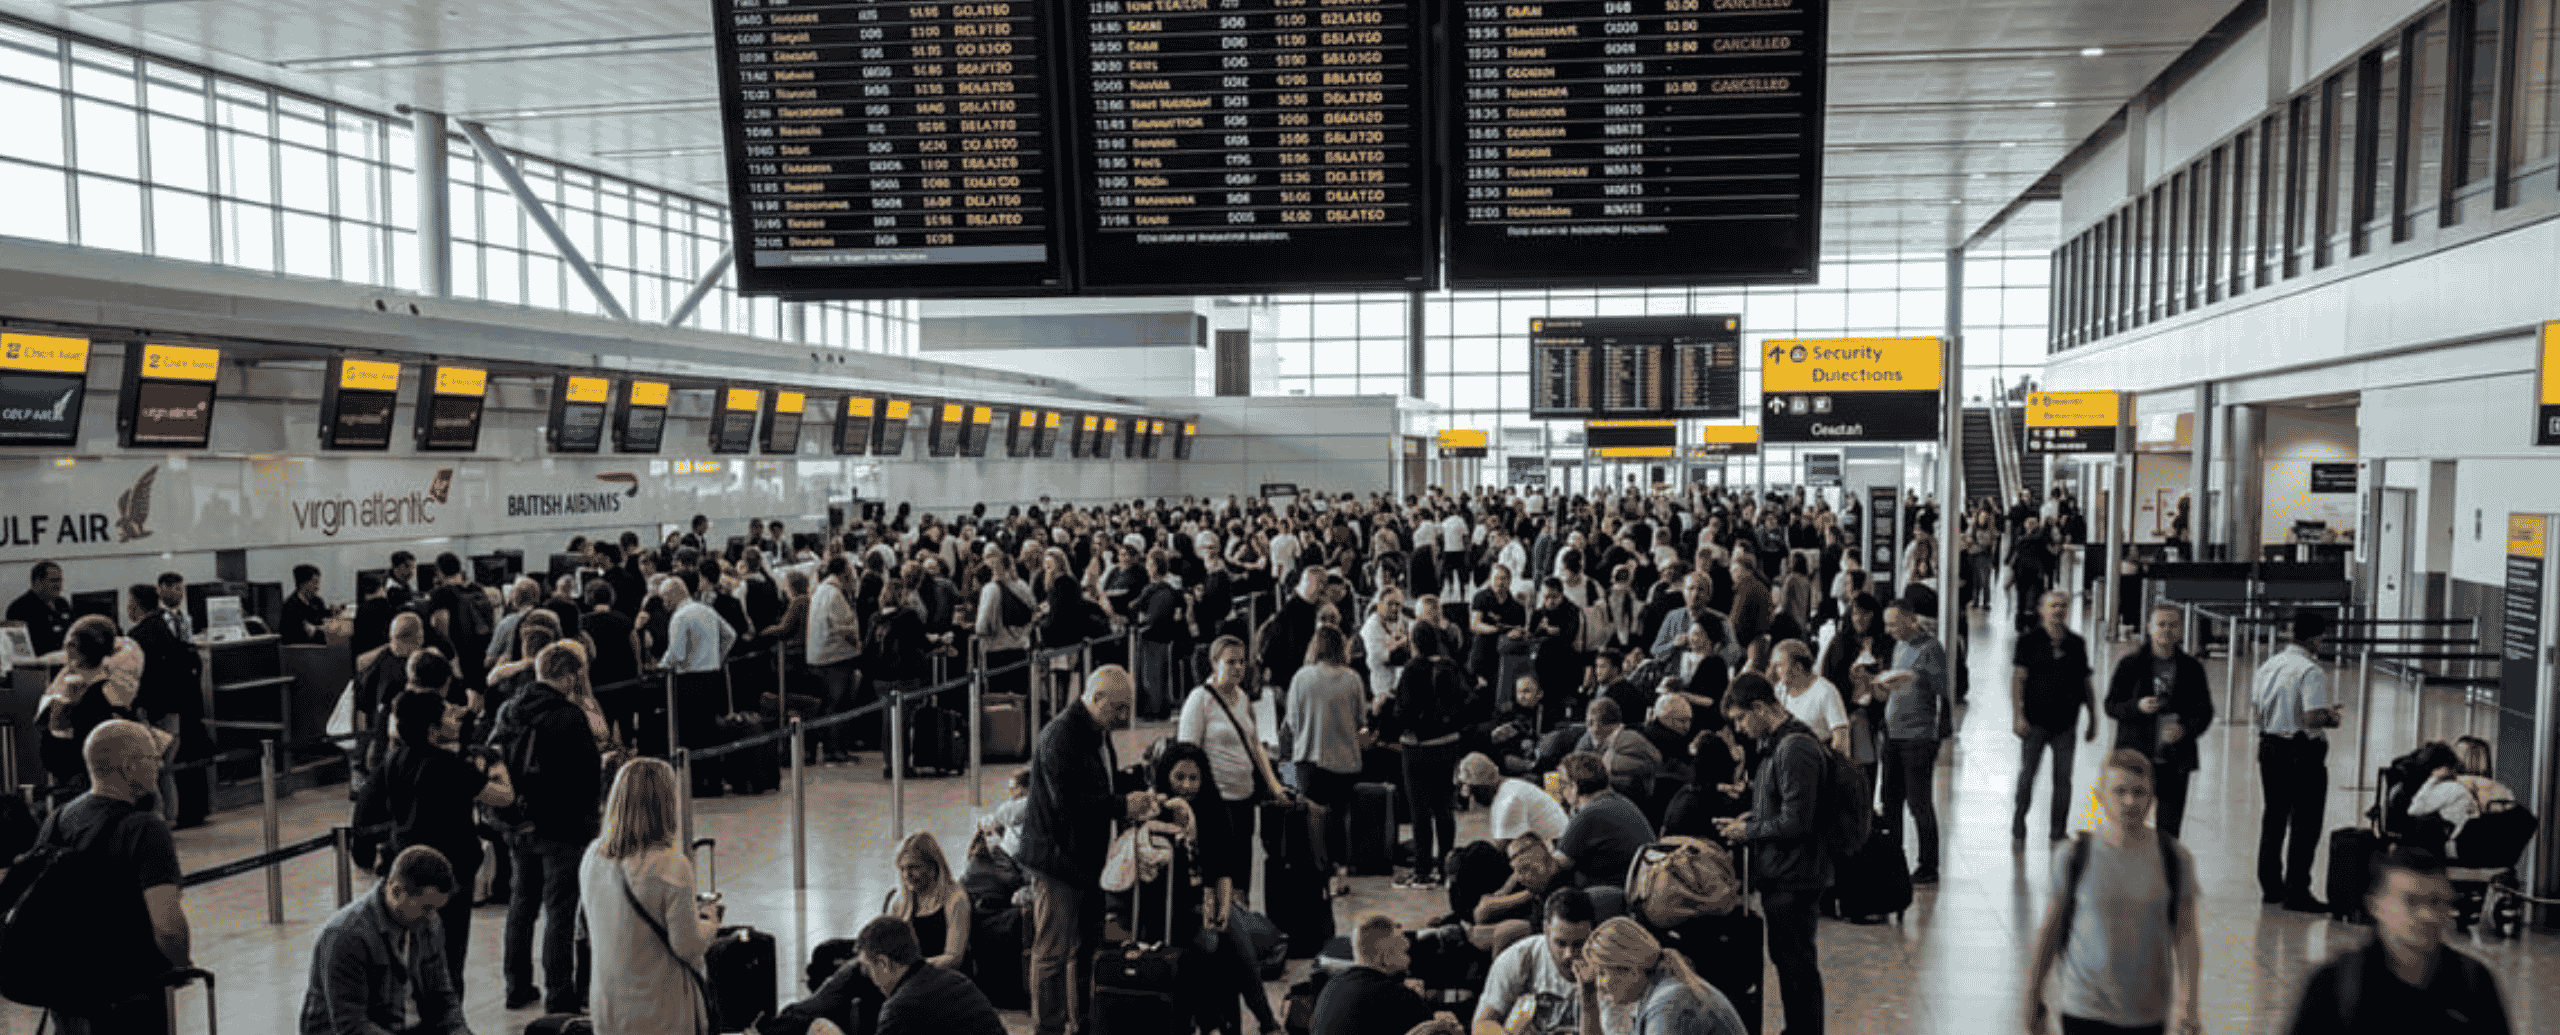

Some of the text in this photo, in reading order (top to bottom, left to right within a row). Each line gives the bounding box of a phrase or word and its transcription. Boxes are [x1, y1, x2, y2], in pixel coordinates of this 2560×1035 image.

[1812, 345, 1883, 363] Security
[57, 513, 112, 544] AIR
[292, 490, 436, 537] virgin atlantic
